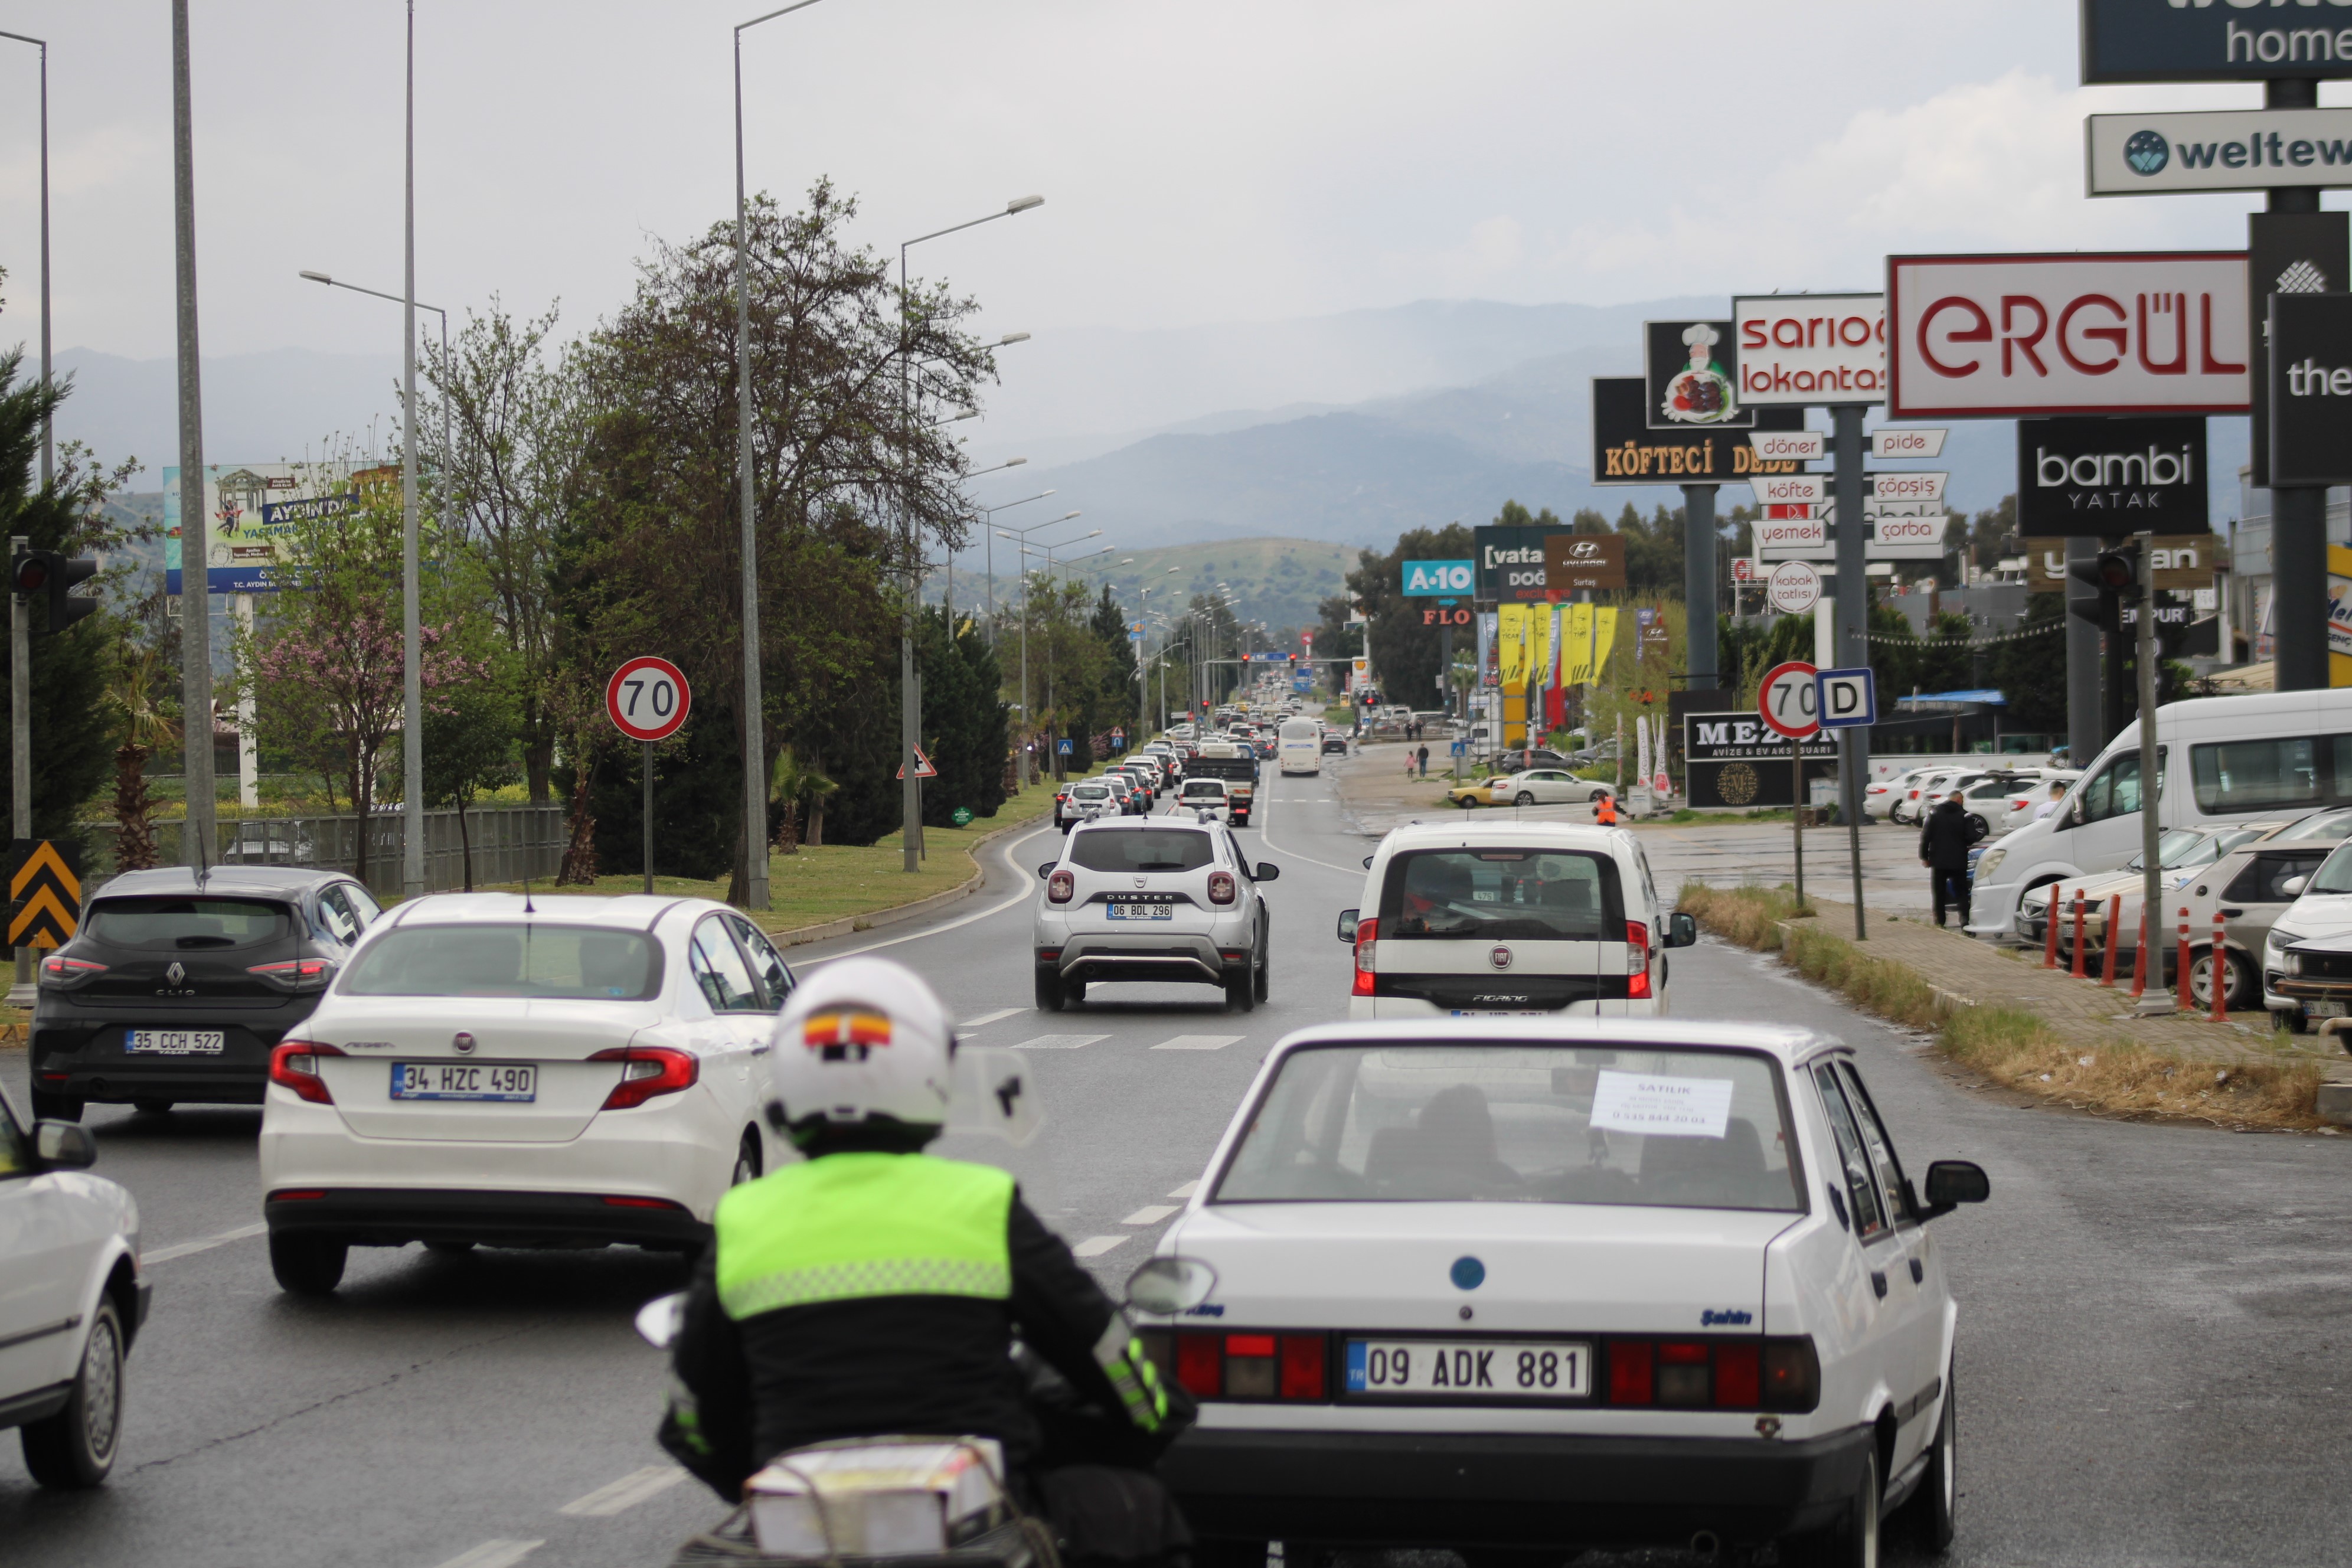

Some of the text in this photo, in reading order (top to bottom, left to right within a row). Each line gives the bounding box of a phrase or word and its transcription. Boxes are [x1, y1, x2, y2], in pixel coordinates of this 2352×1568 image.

[2286, 360, 2352, 396] the
[1763, 438, 1817, 454] döner
[1883, 433, 1925, 454] pide
[1605, 439, 1713, 475] KÖFTECİ
[2037, 445, 2189, 487] bambi
[1767, 482, 1814, 498] köfte
[1877, 477, 1935, 497] çöpşiş
[2067, 491, 2159, 509] YATAK
[1762, 523, 1821, 544] yemek
[1881, 521, 1932, 541] çorba
[1573, 579, 1595, 587] Surtaş
[1776, 574, 1812, 586] kabak
[1777, 589, 1811, 599] tatlısı
[1423, 609, 1471, 625] FLO
[623, 680, 674, 717] 70
[1773, 682, 1817, 717] 70
[1831, 682, 1858, 714] D
[1712, 747, 1742, 756] AVİZE
[1772, 746, 1830, 755] AKSSUARI
[1478, 892, 1492, 900] 476
[1114, 906, 1125, 915] 06
[1131, 905, 1148, 916] BDL
[1153, 905, 1170, 916] 296
[1495, 953, 1507, 962] FIAT
[135, 1033, 152, 1048] 35
[161, 1033, 187, 1048] CCH
[194, 1034, 221, 1049] 522
[405, 1067, 429, 1090] 34
[441, 1069, 480, 1091] HZC
[491, 1069, 530, 1092] 490
[1638, 1083, 1691, 1095] SATILIK
[1348, 1348, 1577, 1389] TR 09 ADK 881
